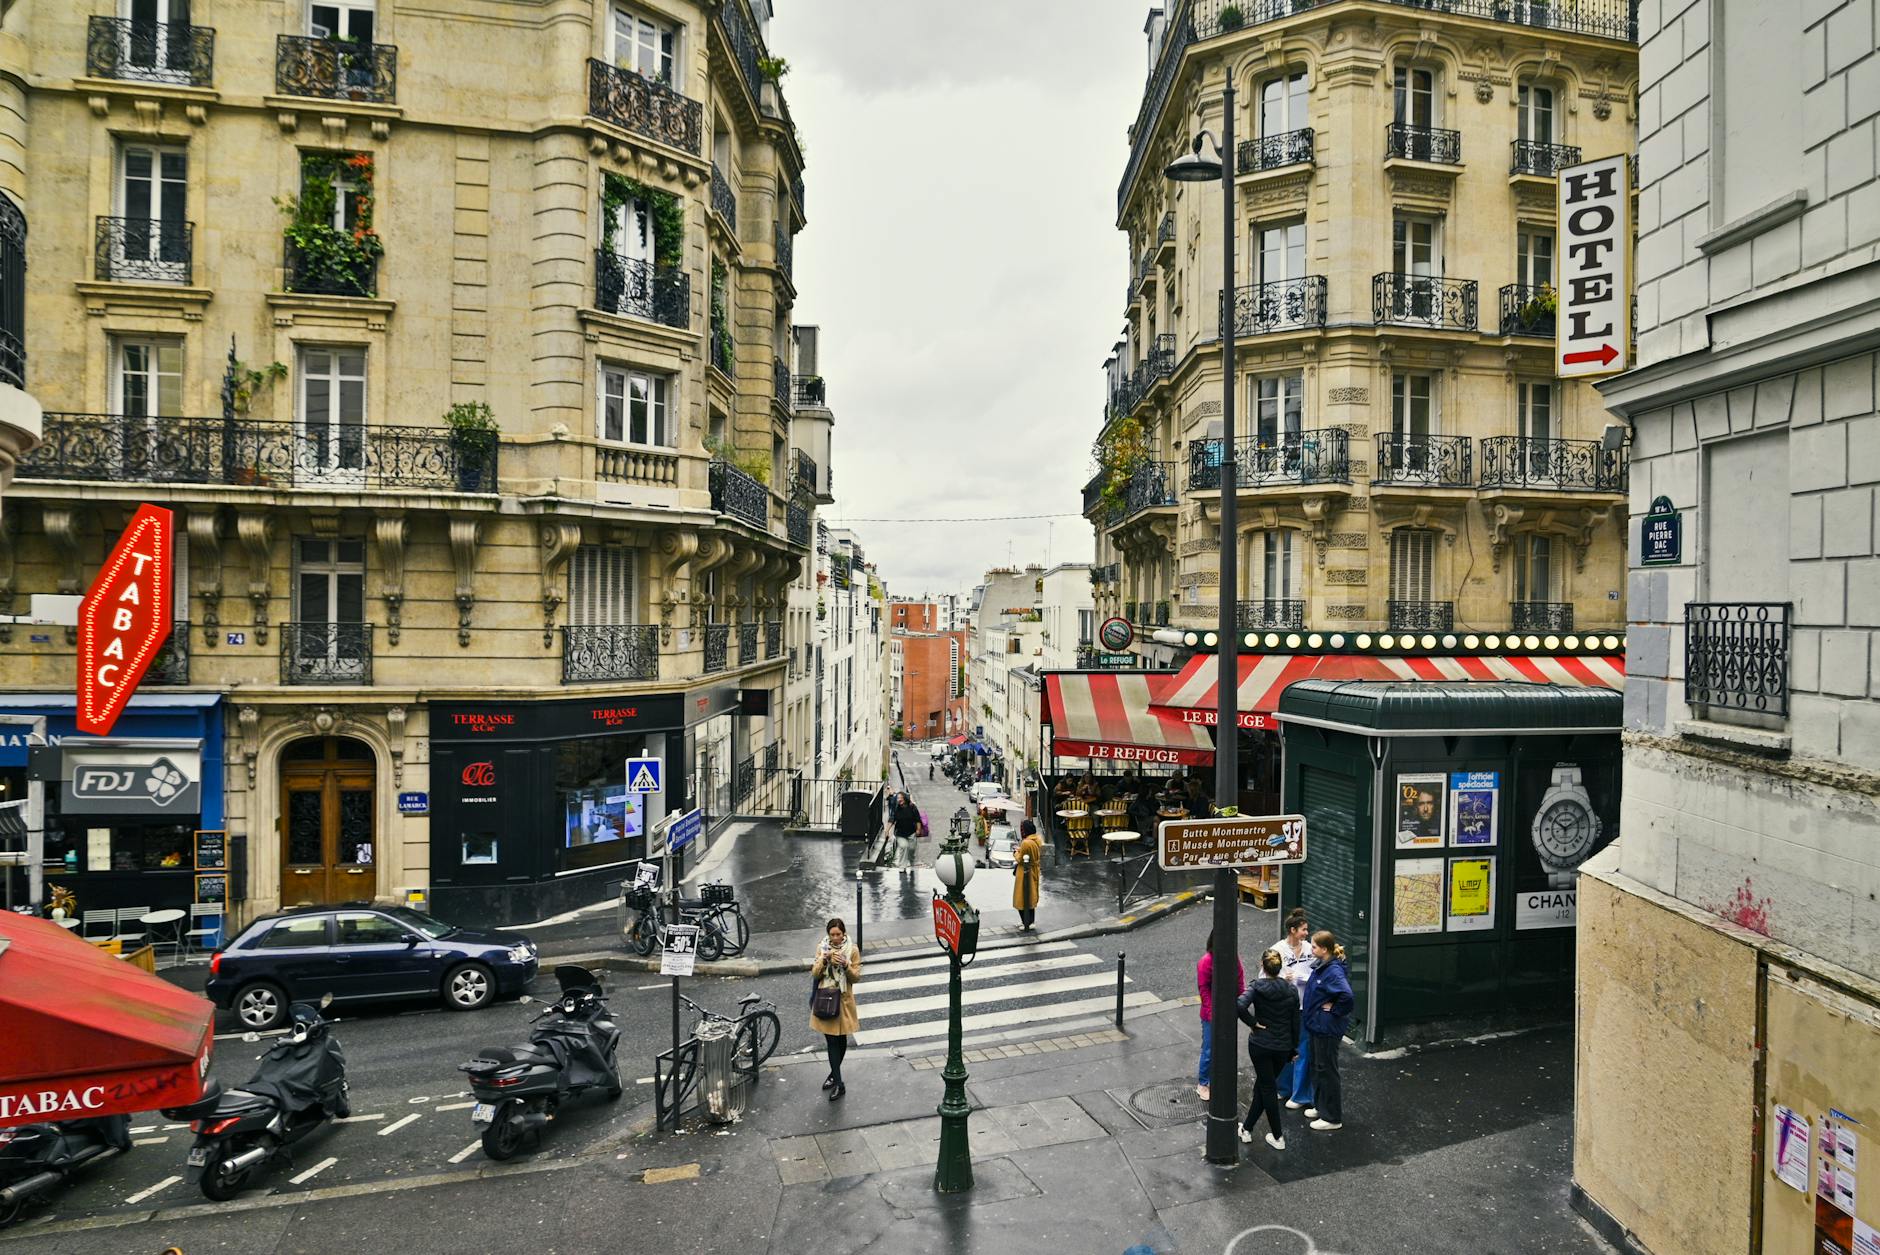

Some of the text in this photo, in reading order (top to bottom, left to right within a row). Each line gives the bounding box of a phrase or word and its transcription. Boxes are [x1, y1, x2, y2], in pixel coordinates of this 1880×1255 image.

[1565, 167, 1617, 341] HOTEL
[1654, 522, 1667, 531] RUE
[1648, 530, 1673, 540] PIERRE
[1654, 541, 1667, 549] DAC
[97, 552, 153, 687] TABAC
[228, 634, 244, 644] 74
[1109, 656, 1134, 664] REFUGE
[592, 708, 637, 719] TERRASSE
[1183, 711, 1265, 727] LE RUGE
[451, 714, 515, 725] TERRASSE
[1088, 745, 1179, 763] LE REFUGE
[80, 771, 135, 791] FDJ
[1182, 826, 1267, 838] Butte Montmartre
[1182, 840, 1213, 850] Musée
[1183, 852, 1198, 862] Par
[1253, 847, 1284, 858] Saul
[1555, 909, 1570, 919] J12
[0, 1086, 105, 1119] TABAC
